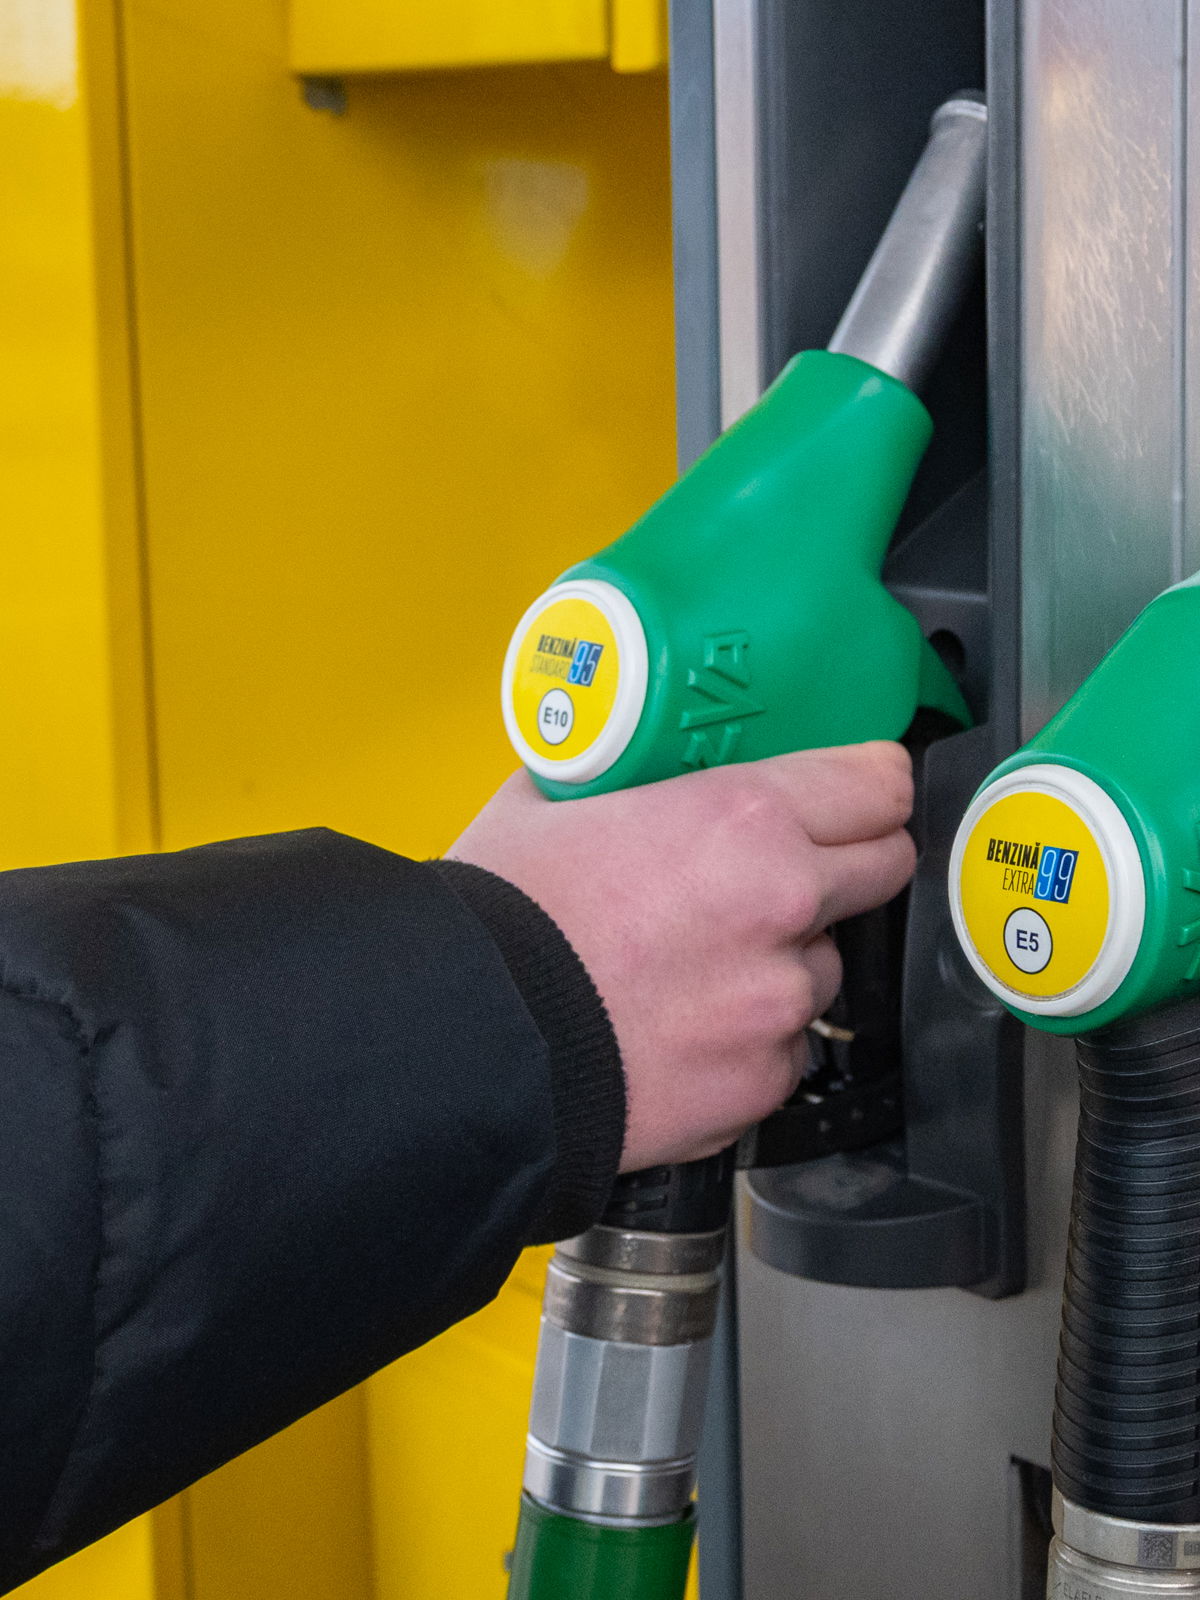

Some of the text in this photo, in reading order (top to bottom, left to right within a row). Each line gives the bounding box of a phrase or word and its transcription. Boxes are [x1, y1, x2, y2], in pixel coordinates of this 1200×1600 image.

[569, 642, 601, 686] 95
[543, 706, 568, 728] E10
[986, 838, 1041, 870] BENZINĂ
[1002, 867, 1035, 896] EXTRA
[1037, 849, 1076, 901] 99
[1016, 929, 1039, 952] E5
